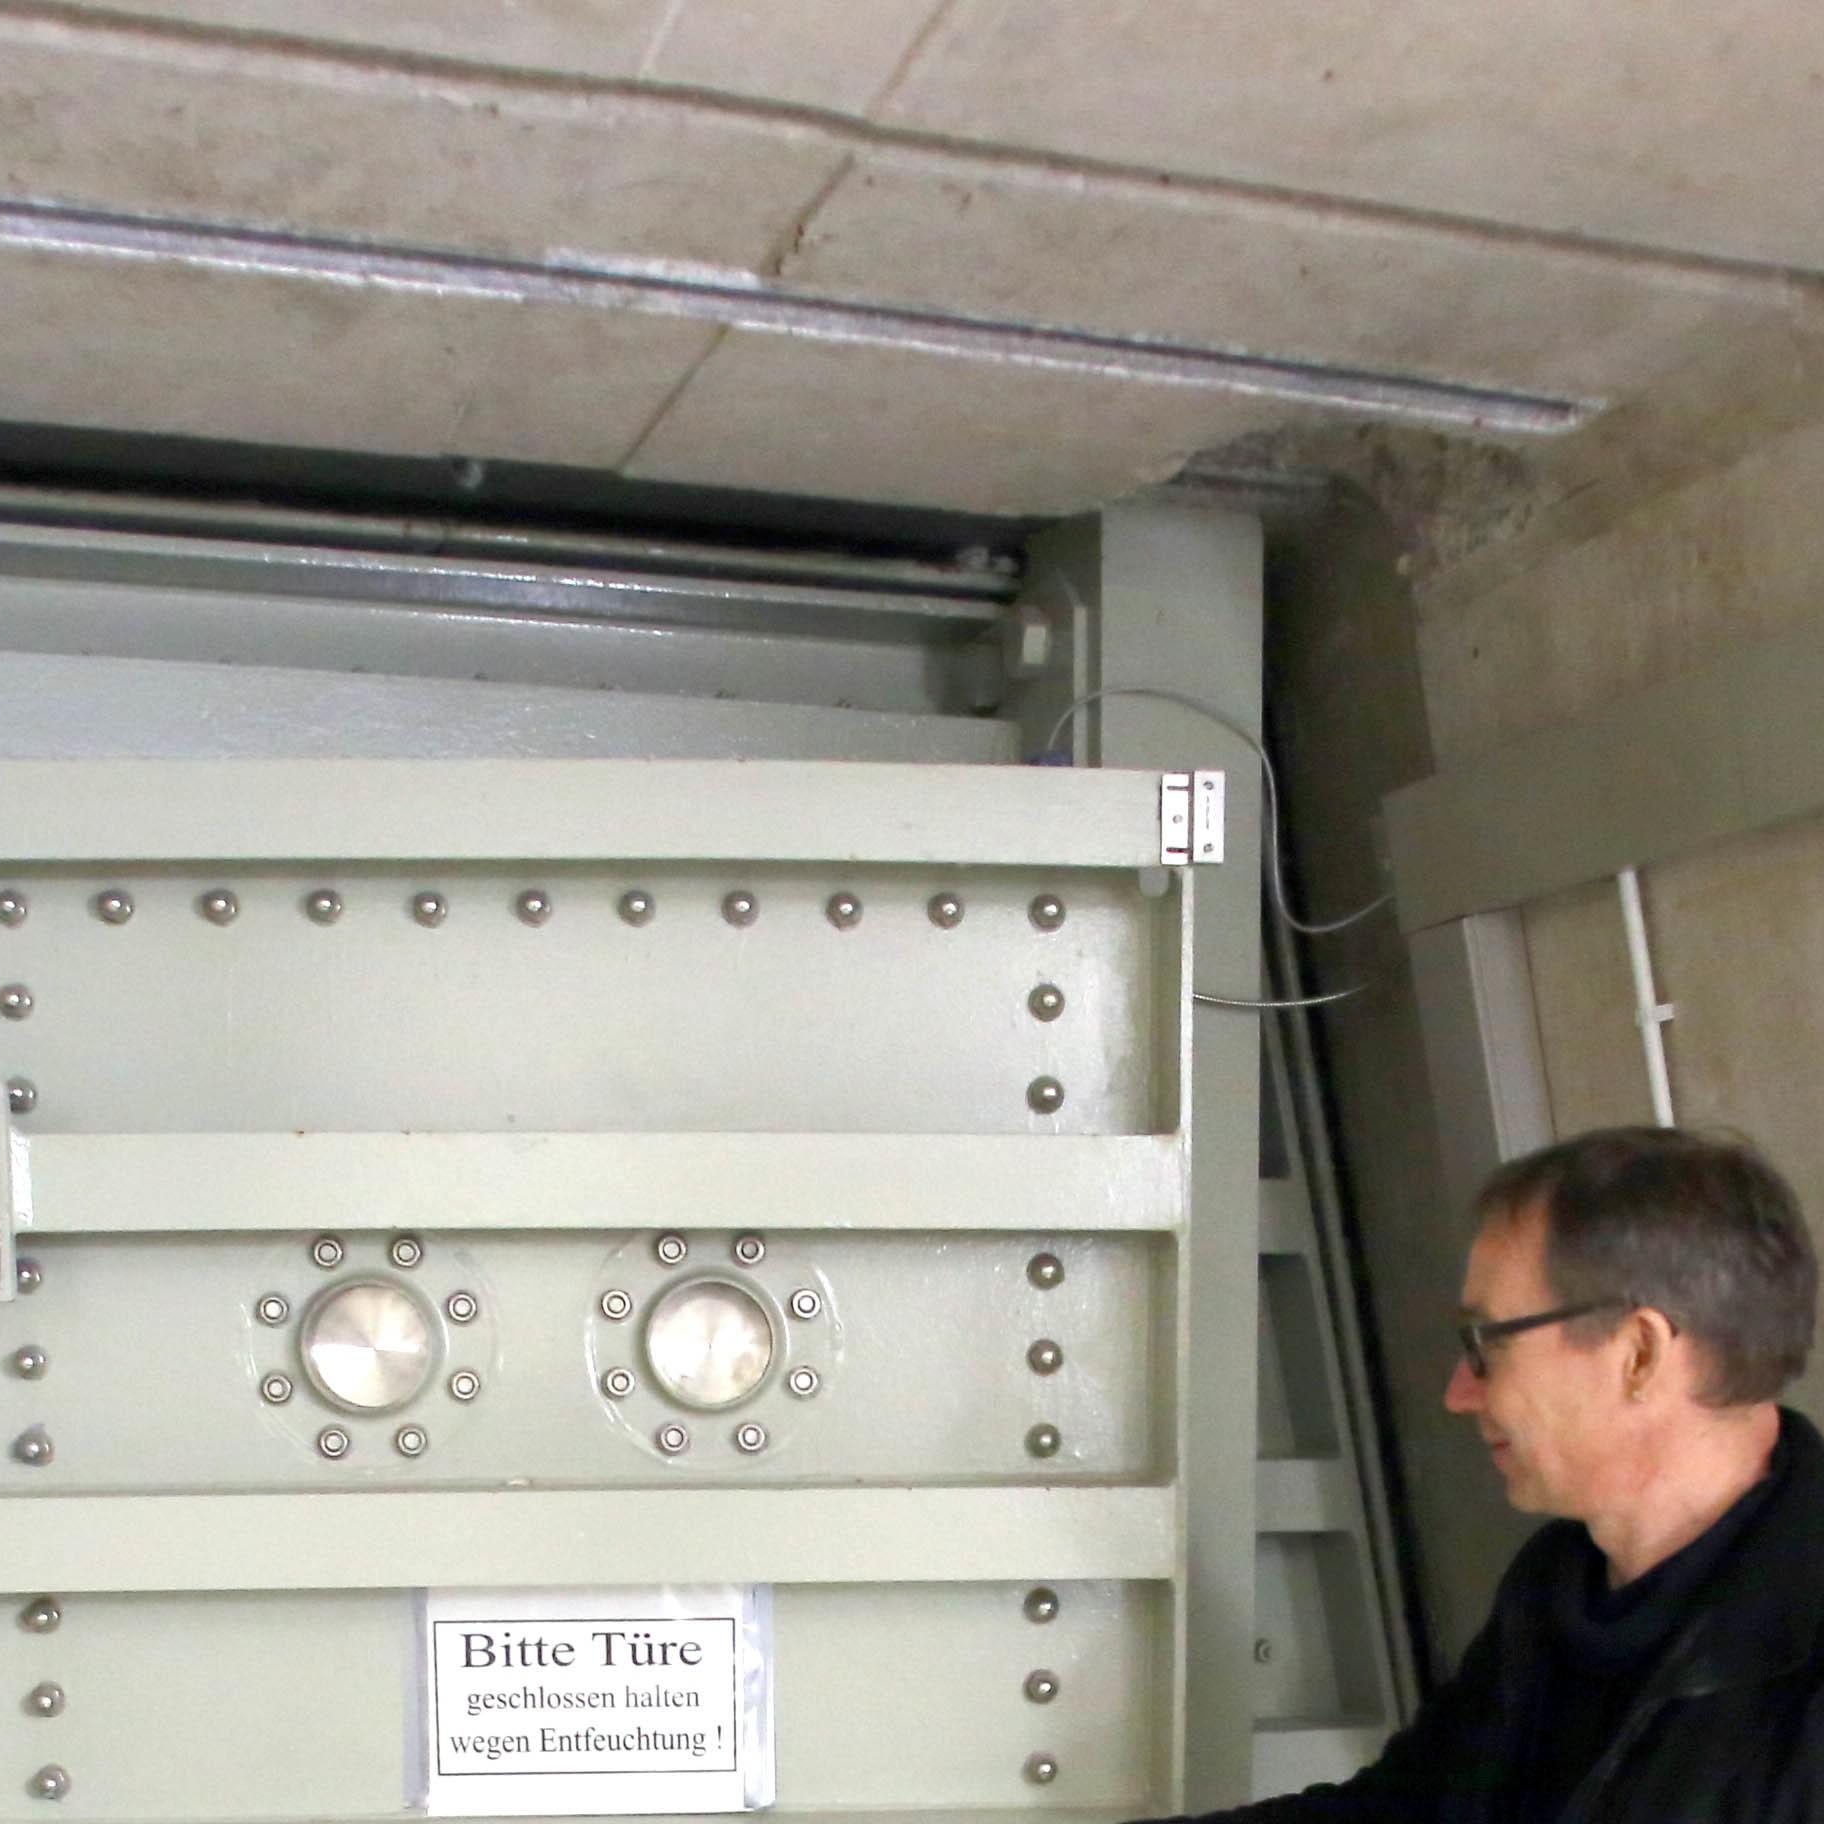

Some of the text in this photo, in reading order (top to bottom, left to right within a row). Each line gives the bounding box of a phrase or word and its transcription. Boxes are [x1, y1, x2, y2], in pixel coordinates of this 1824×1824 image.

[461, 1631, 703, 1668] Bitte Türe
[466, 1685, 700, 1715] geschlossen halten
[450, 1725, 723, 1760] wegen Entfeuchtung !
